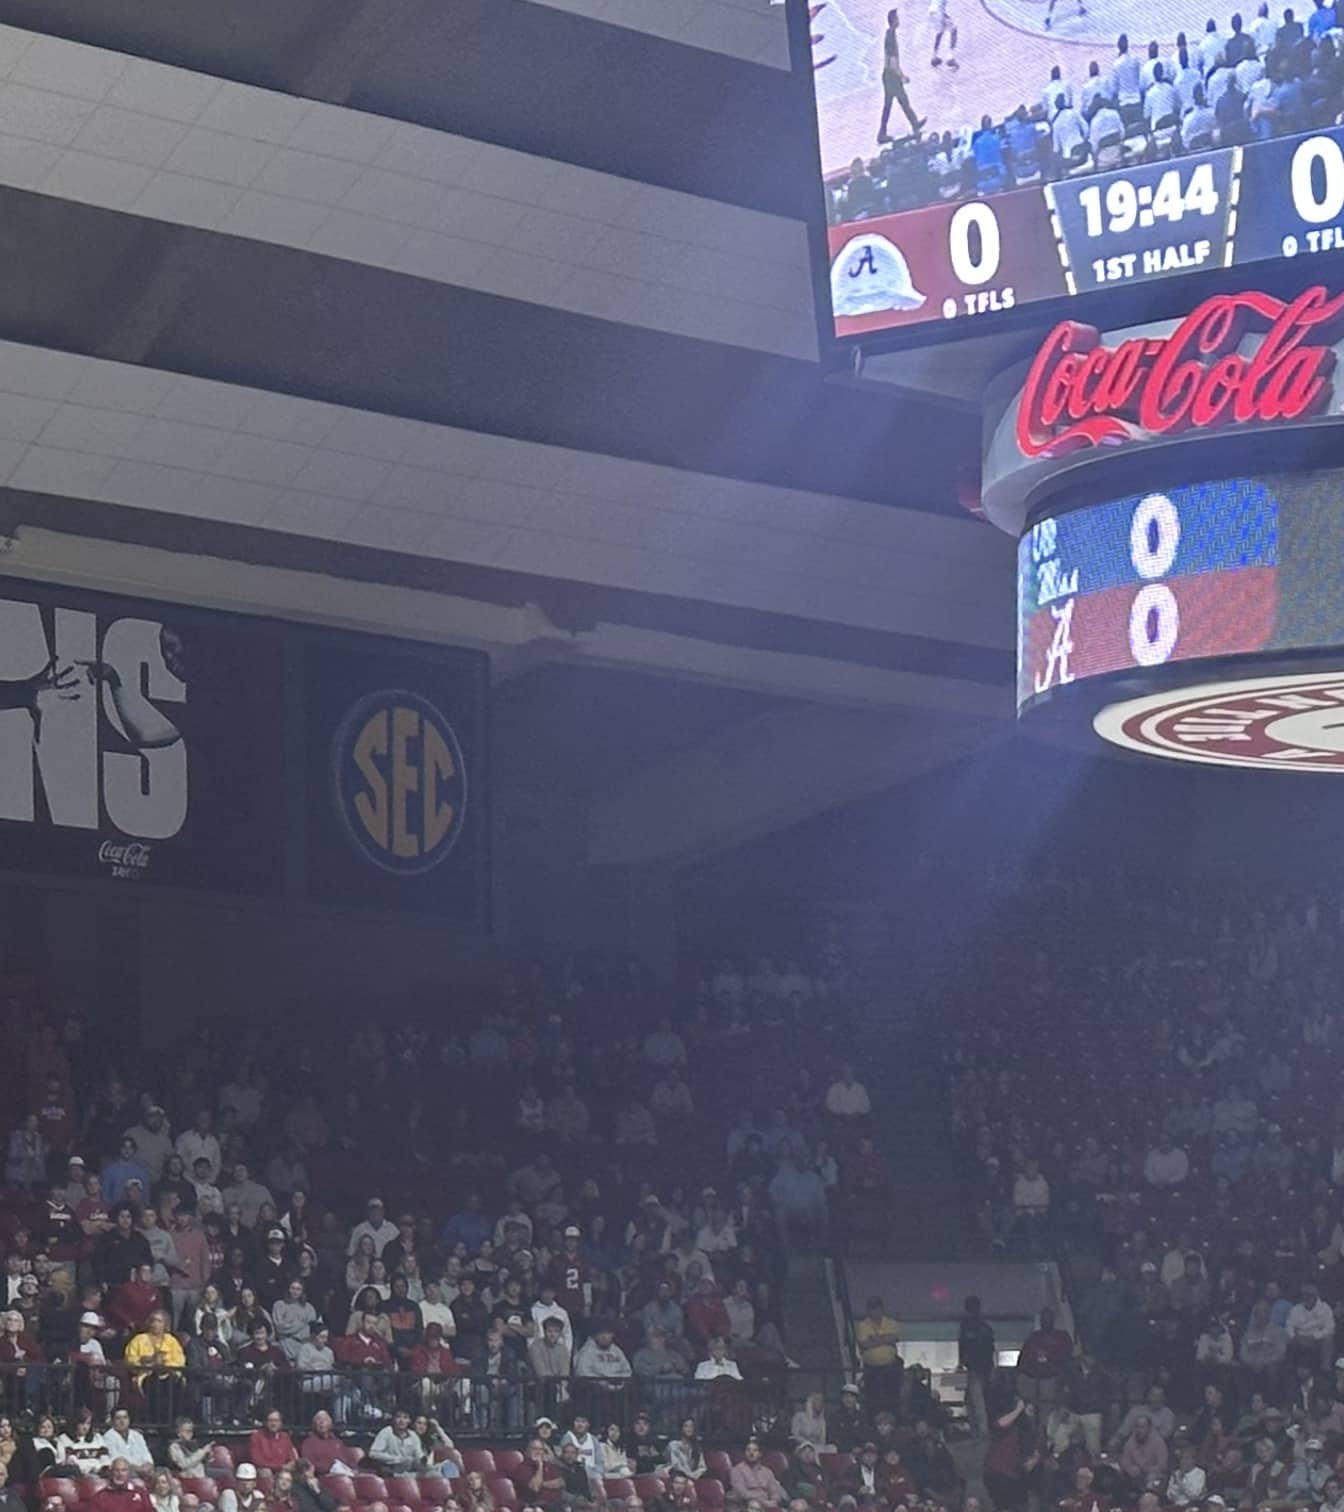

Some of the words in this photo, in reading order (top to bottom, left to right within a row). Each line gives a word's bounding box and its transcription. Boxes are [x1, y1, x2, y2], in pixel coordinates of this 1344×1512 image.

[1078, 162, 1218, 237] 19:44
[948, 201, 1001, 286] 0
[1091, 253, 1136, 283] 1ST
[1141, 241, 1210, 274] HALF
[1283, 238, 1299, 257] 0
[942, 299, 958, 318] 0
[963, 286, 1015, 315] TFLS
[1130, 493, 1181, 579] 0
[1128, 583, 1180, 666] 0
[353, 706, 456, 857] SEC
